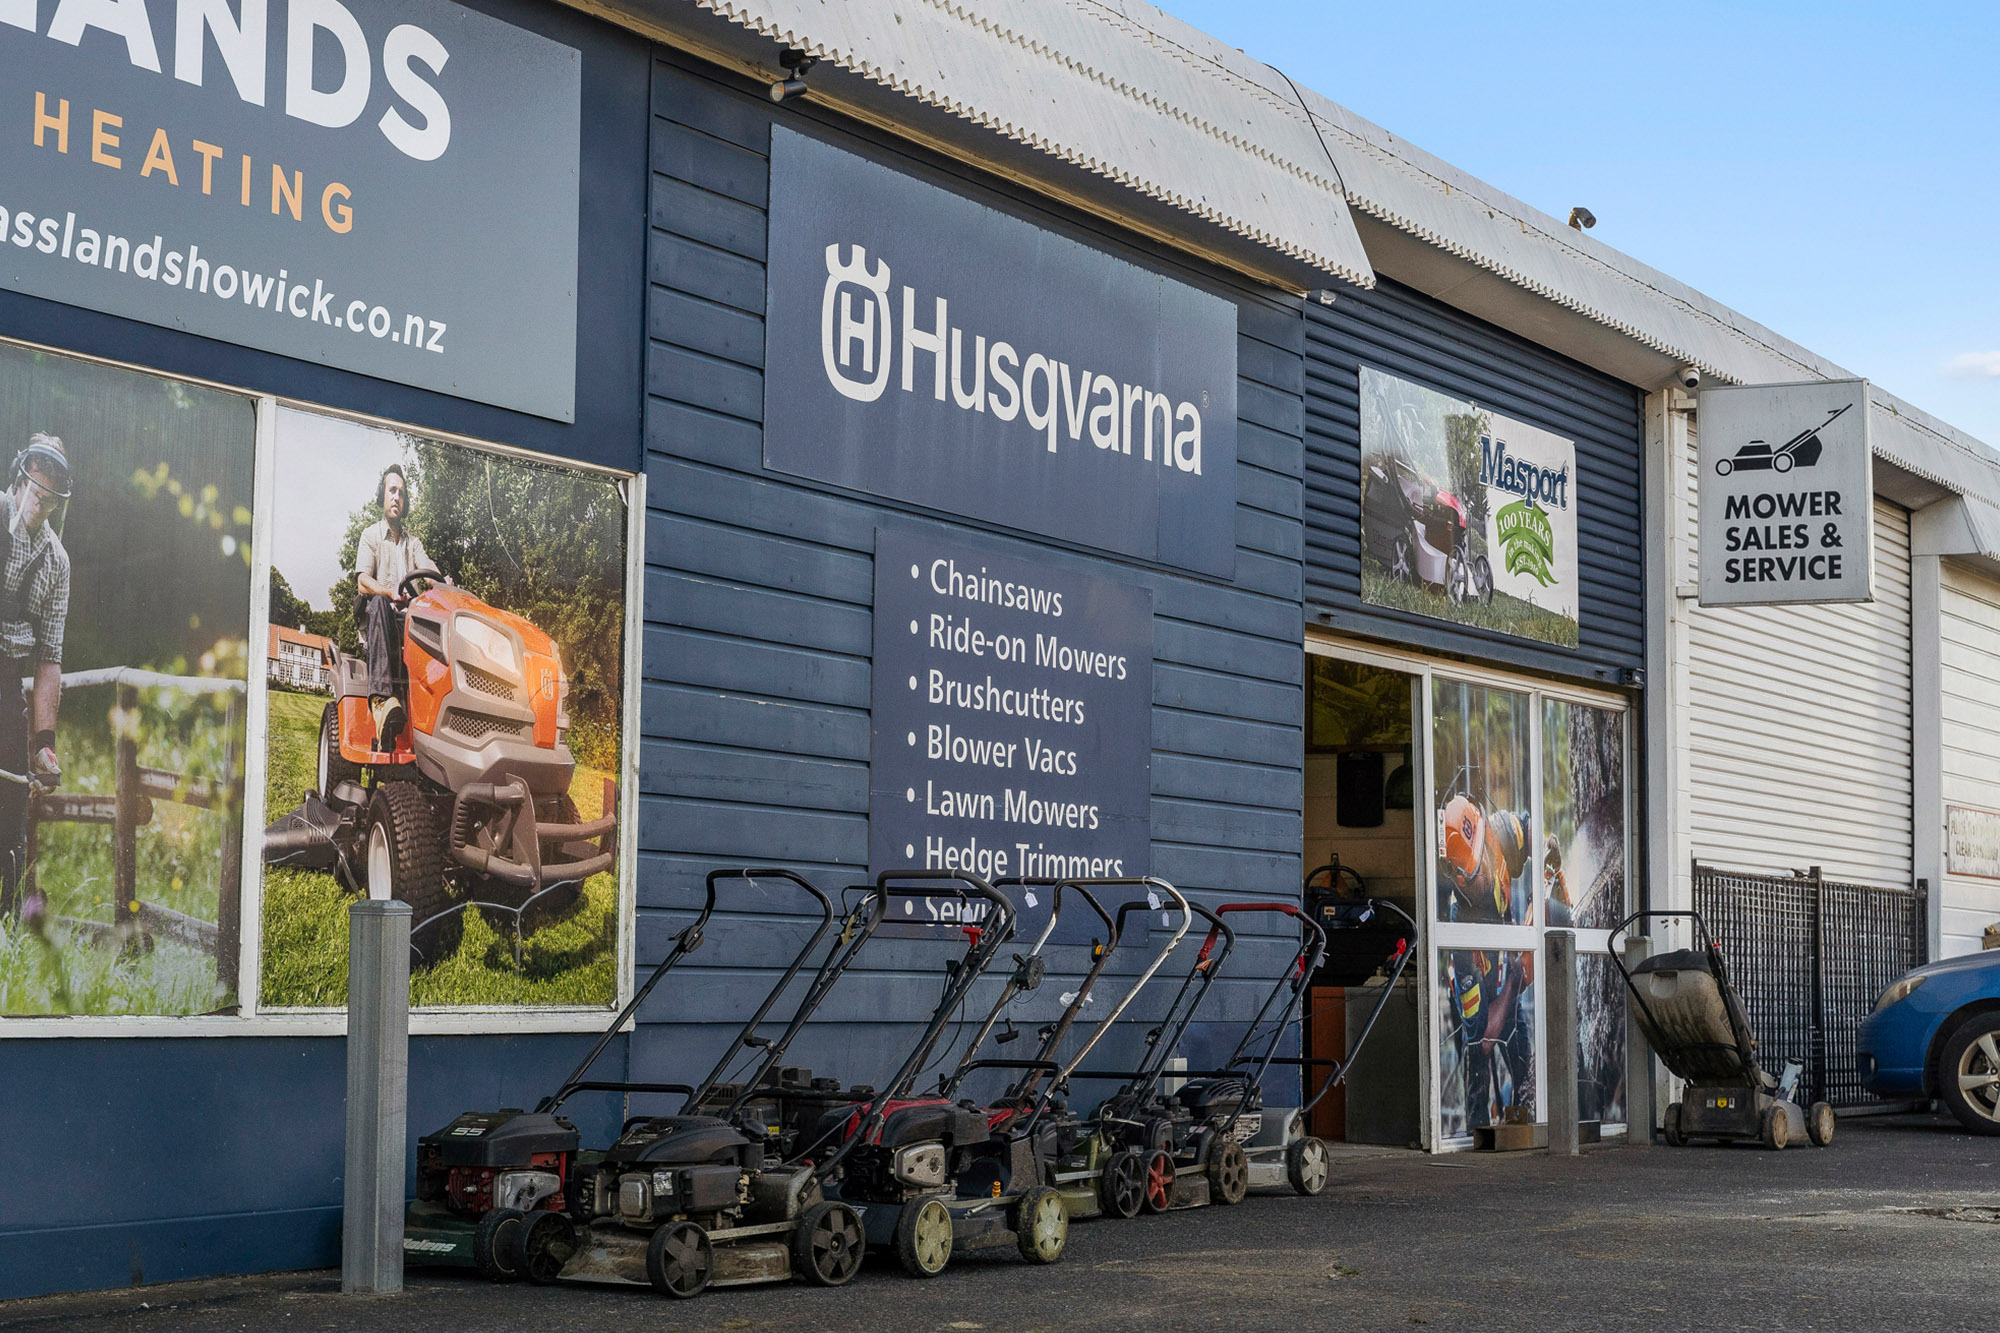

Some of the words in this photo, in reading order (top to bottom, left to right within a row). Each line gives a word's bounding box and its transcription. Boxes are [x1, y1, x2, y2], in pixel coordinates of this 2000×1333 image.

[33, 91, 353, 234] HEATING
[901, 285, 1202, 476] Husqvarna
[1479, 435, 1569, 509] Masport
[1499, 512, 1517, 535] 100
[1519, 511, 1550, 546] YEARS
[1724, 490, 1843, 520] MOWER
[1725, 523, 1810, 552] SALES
[1820, 522, 1844, 549] &
[930, 558, 1063, 617] Chainsaws
[1724, 554, 1842, 584] SERVICE
[929, 613, 1026, 663] Ride-on
[1035, 633, 1127, 681] Mowers
[928, 668, 1085, 725] Brushcutters
[927, 724, 1017, 769] Blower
[1024, 737, 1077, 776] Vacs
[926, 780, 995, 821] Lawn
[1004, 788, 1099, 830] Mowers
[925, 835, 1008, 884] Hedge
[1015, 842, 1123, 879] Trimmers
